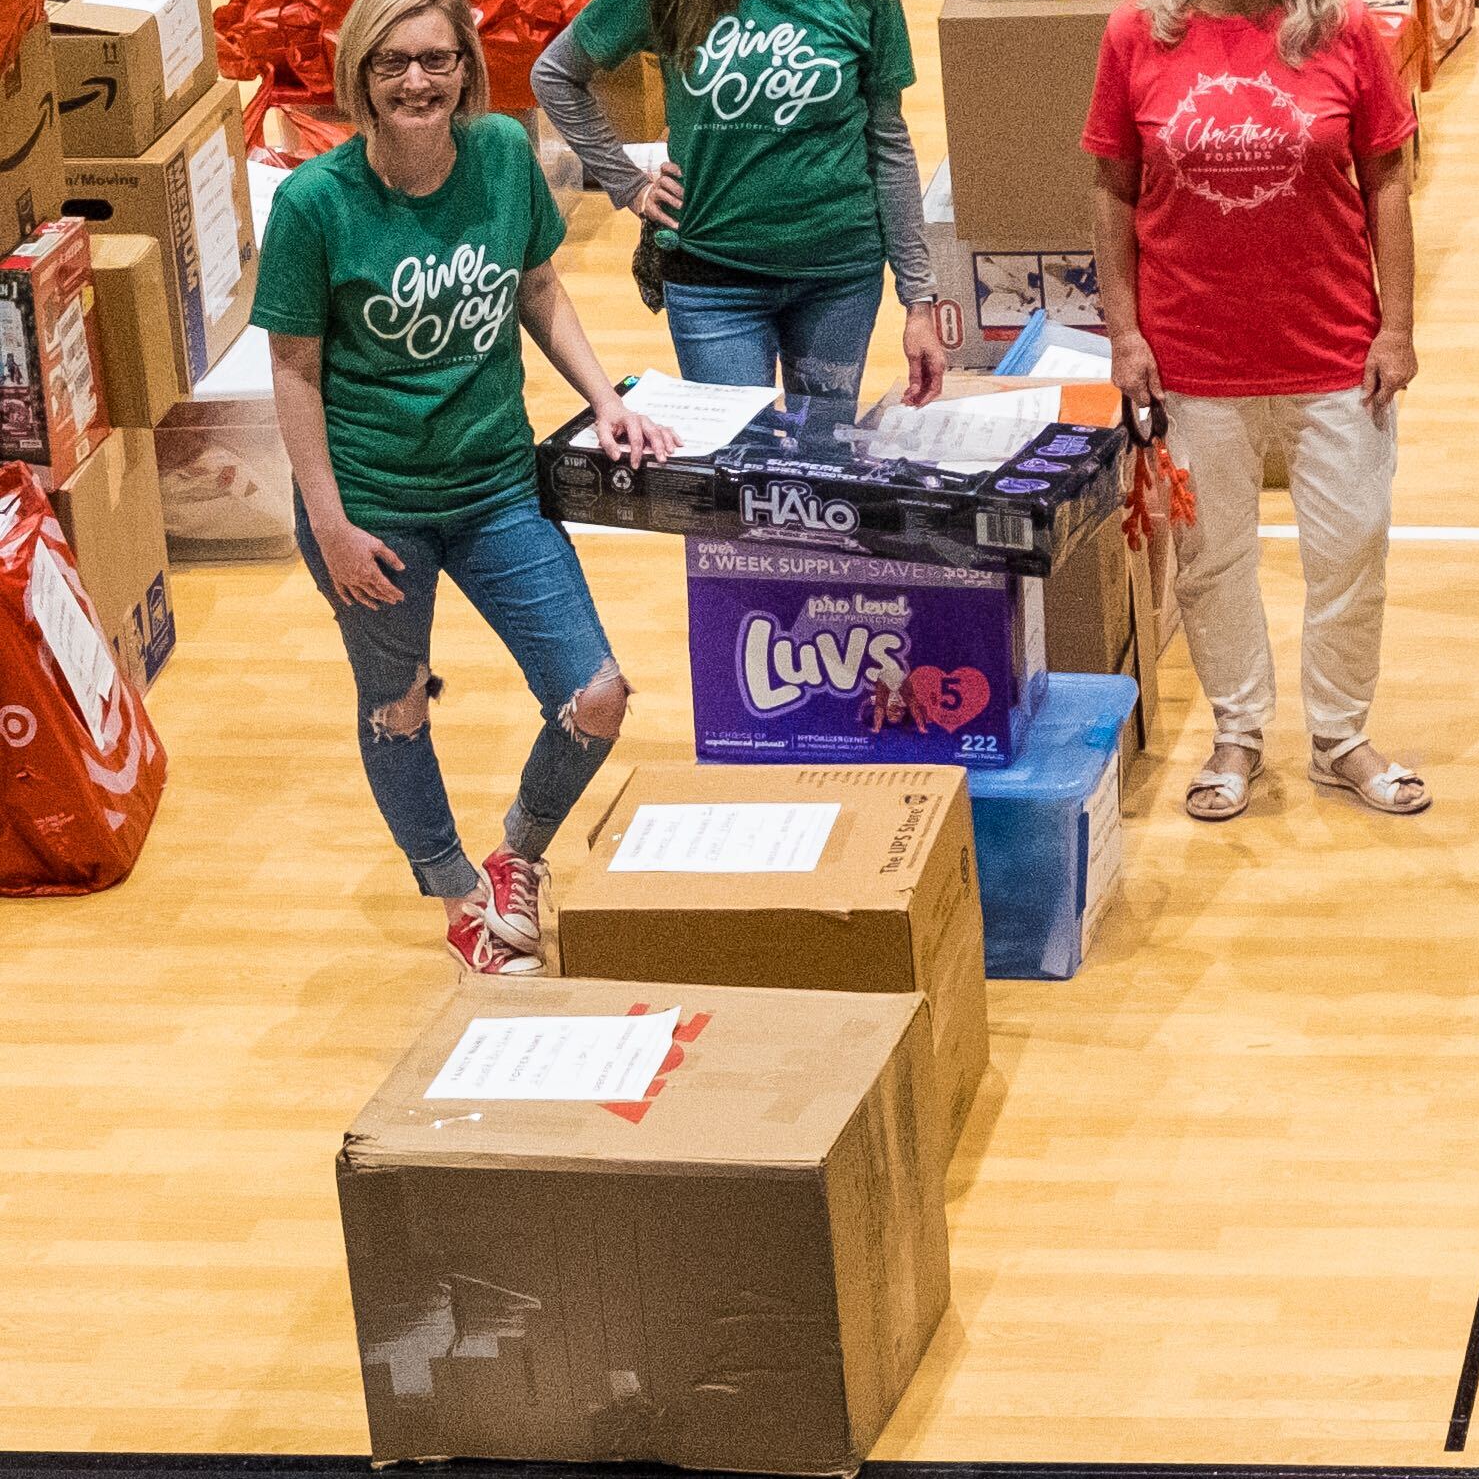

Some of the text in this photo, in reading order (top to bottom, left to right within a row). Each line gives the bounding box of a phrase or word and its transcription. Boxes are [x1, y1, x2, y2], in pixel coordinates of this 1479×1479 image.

[1205, 151, 1272, 161] FOSTERS
[742, 481, 859, 533] HALO
[699, 554, 709, 569] 6
[717, 556, 775, 571] WEEK
[809, 595, 911, 618] pro level
[961, 735, 998, 752] 222
